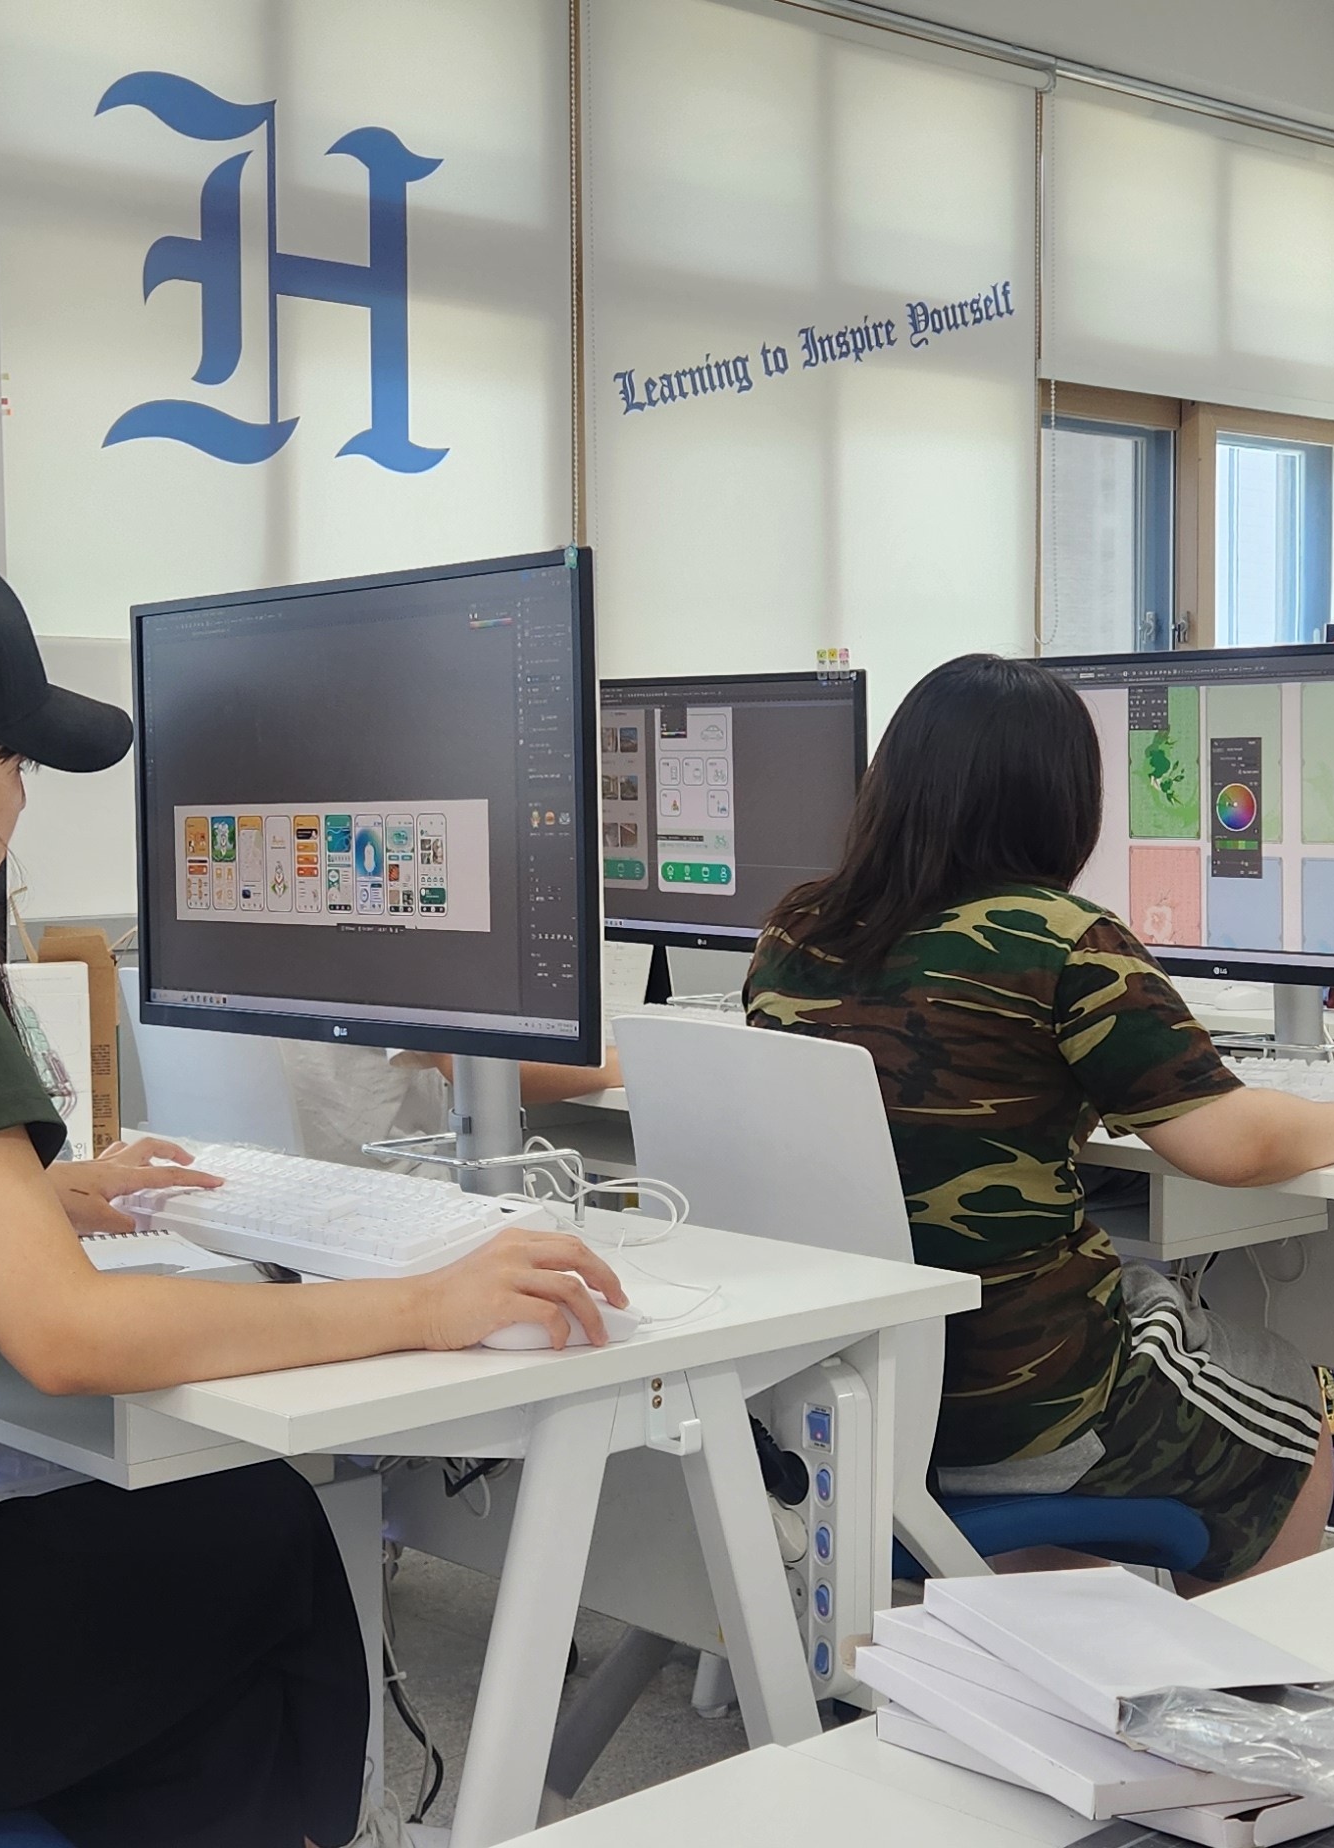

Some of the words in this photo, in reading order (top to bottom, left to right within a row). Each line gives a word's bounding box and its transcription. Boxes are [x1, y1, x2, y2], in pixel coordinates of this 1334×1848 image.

[614, 355, 754, 415] Learning
[760, 341, 789, 378] to
[798, 314, 899, 370] Inspire
[906, 280, 1015, 349] Yourself
